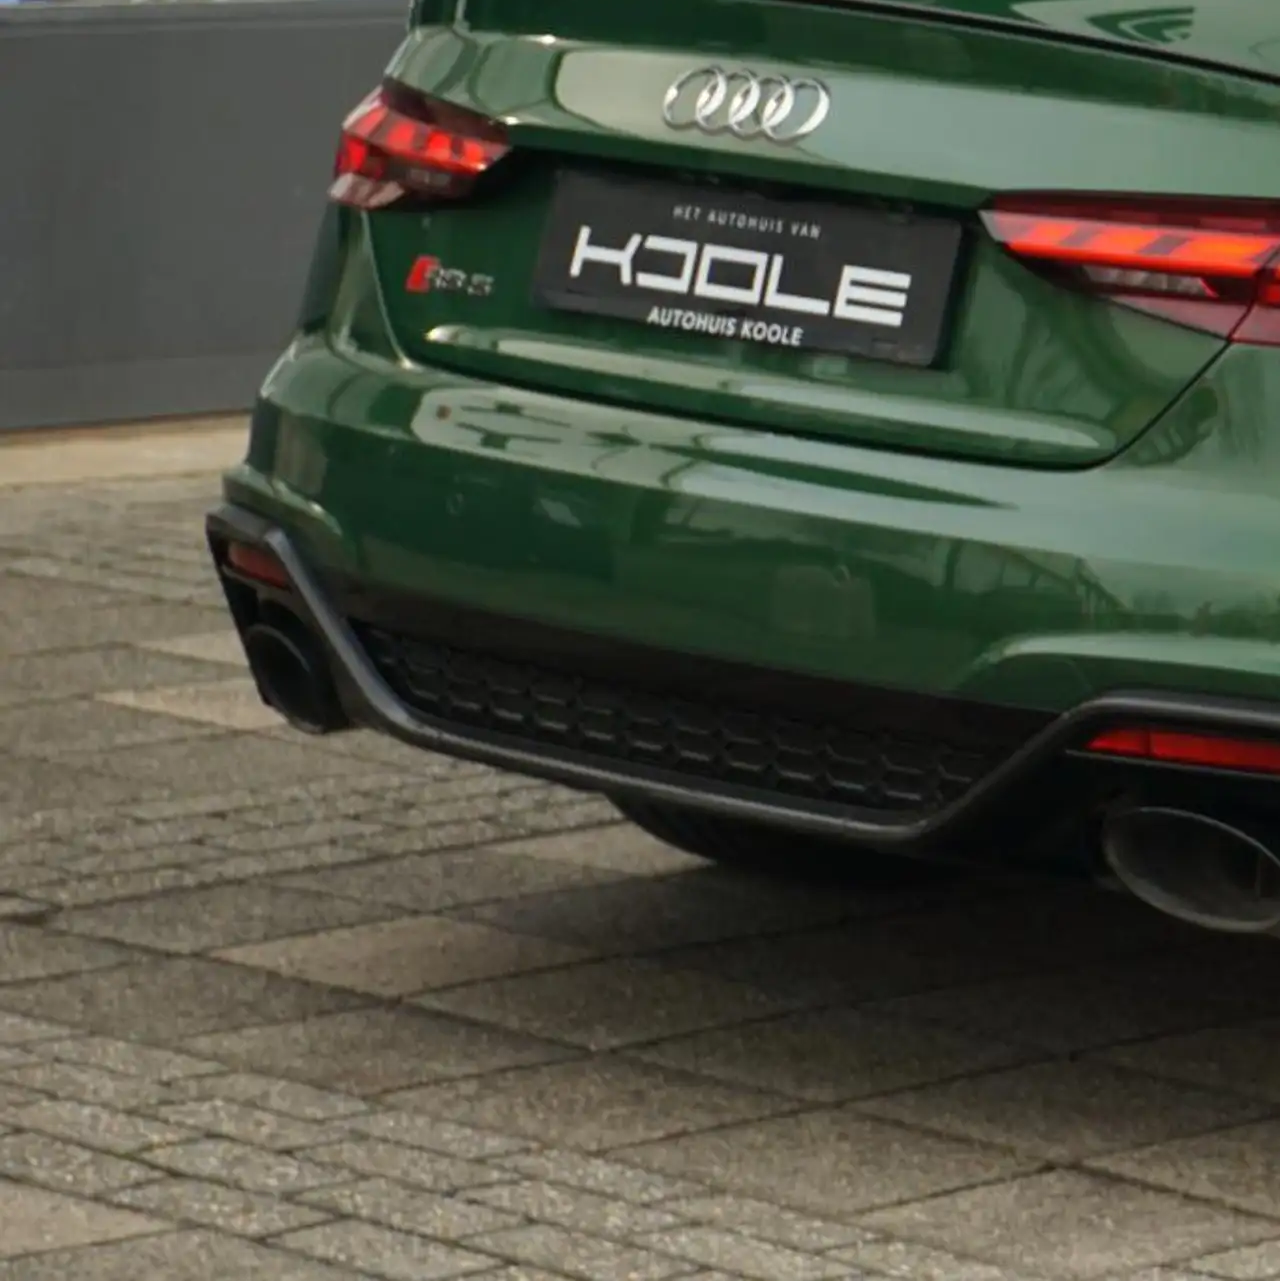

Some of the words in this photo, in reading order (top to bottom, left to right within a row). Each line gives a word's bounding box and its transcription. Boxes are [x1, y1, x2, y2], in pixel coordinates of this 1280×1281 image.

[672, 204, 701, 220] HET
[707, 209, 783, 234] AUTOHUIS
[790, 221, 821, 240] VAN
[646, 305, 738, 337] AUTOHUIS
[740, 320, 804, 347] KOOLE
